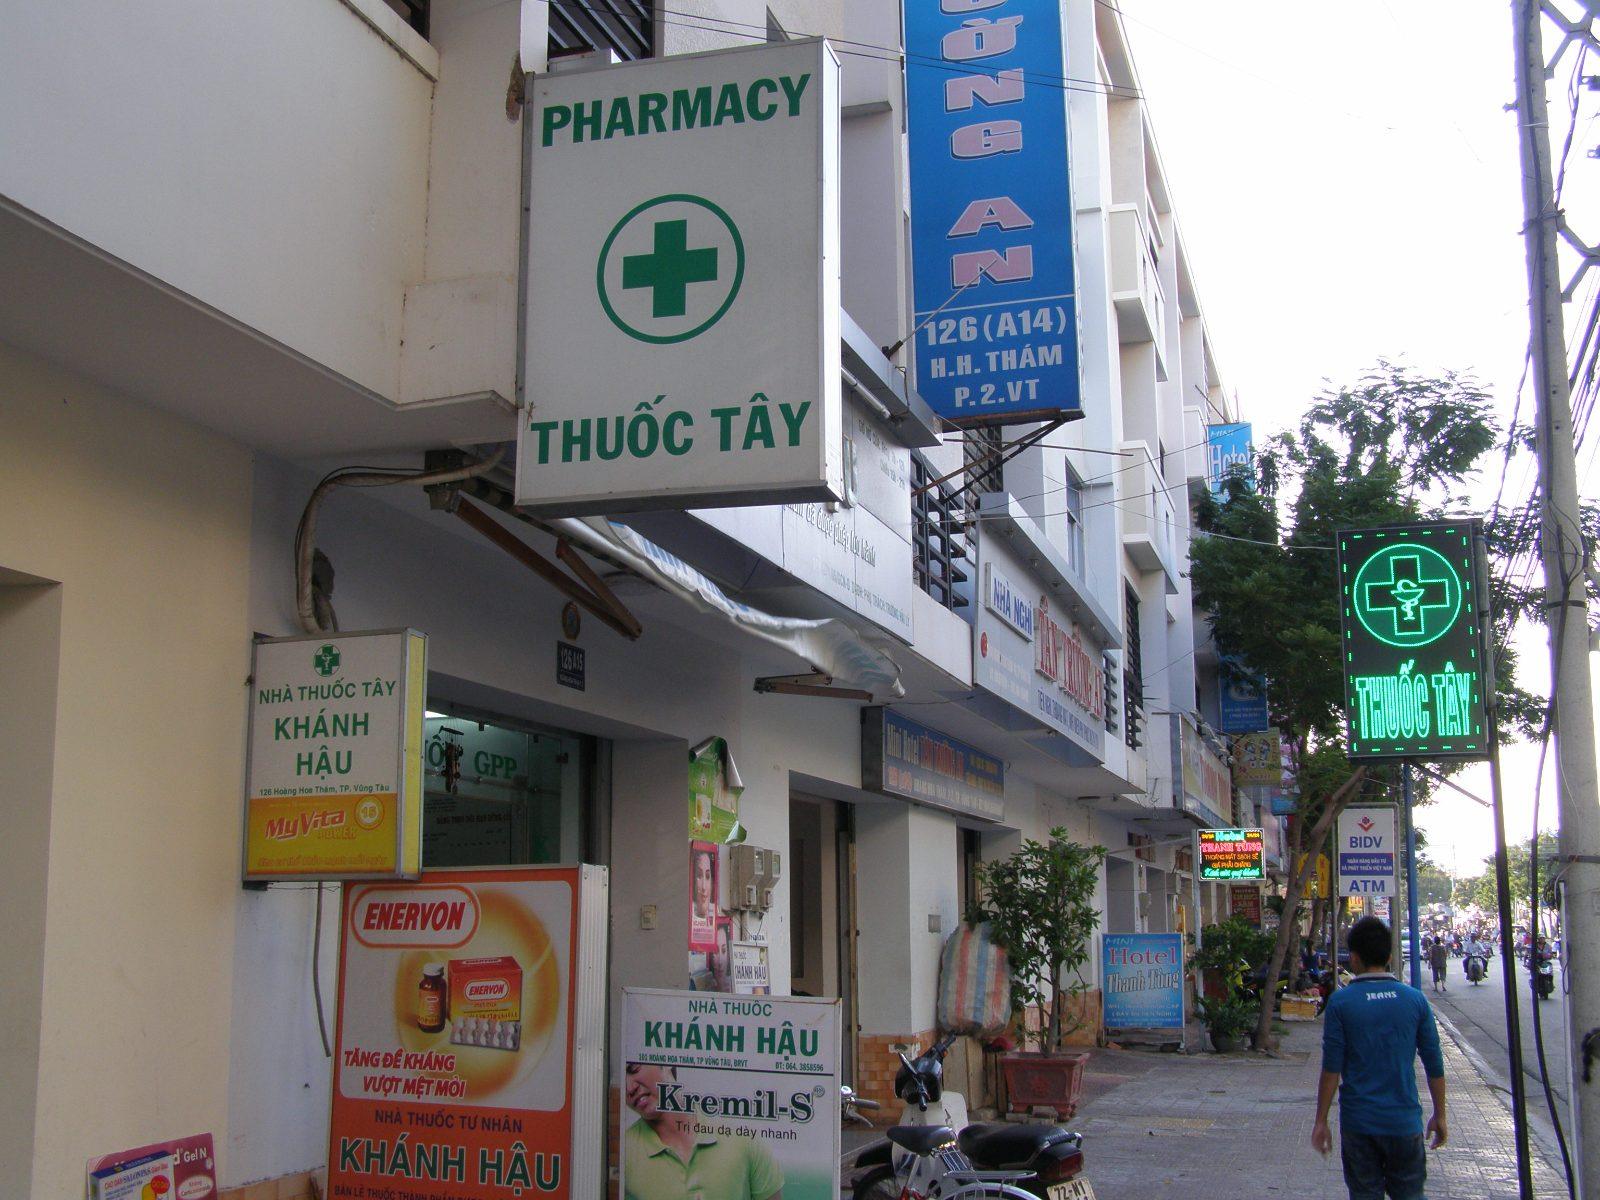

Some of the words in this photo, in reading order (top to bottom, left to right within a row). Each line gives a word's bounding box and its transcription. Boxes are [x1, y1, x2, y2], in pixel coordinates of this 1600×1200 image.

[542, 74, 811, 148] PHARMACY
[946, 196, 1035, 290] AN
[924, 316, 978, 346] 126
[983, 306, 1067, 343] (A14)
[931, 354, 981, 379] H.H.
[986, 343, 1063, 371] THÁM
[531, 395, 694, 465] THUỐC
[711, 392, 811, 452] TÂY
[993, 578, 1011, 620] NHÀ
[1014, 596, 1033, 636] NGHỈ
[260, 683, 293, 704] NHÀ
[298, 676, 356, 701] THUỐC
[362, 676, 396, 697] TÂY
[1356, 659, 1430, 739] THUỐC
[1432, 661, 1471, 737] TÂY
[274, 708, 369, 741] KHÁNH
[296, 745, 352, 780] HẬU
[475, 750, 518, 780] GPP
[1350, 836, 1383, 849] BIDV
[1349, 880, 1385, 892] ATM
[363, 901, 466, 932] ENERVON
[1108, 946, 1176, 966] Hotel
[1107, 969, 1145, 993] Thanh
[689, 997, 718, 1015] NHÀ
[722, 998, 773, 1017] THUỐC
[644, 1016, 745, 1053] KHÁNH
[757, 1020, 819, 1061] HẬU
[345, 1048, 381, 1068] TĂNG
[403, 1050, 456, 1071] KHÁNG
[363, 1074, 402, 1097] VƯỢT
[402, 1075, 434, 1099] MỆT
[657, 1083, 814, 1123] Kremil-S
[375, 1108, 402, 1126] NHÀ
[407, 1109, 454, 1130] THUỐC
[459, 1114, 480, 1130] TƯ
[481, 1115, 523, 1134] NHÂN
[675, 1120, 690, 1135] Trị
[694, 1122, 714, 1134] đau
[717, 1124, 731, 1138] dạ
[735, 1125, 758, 1141] dày
[760, 1127, 798, 1142] nhanh
[183, 1147, 198, 1163] Gel
[200, 1146, 208, 1159] N
[340, 1132, 466, 1183] KHÁNH
[479, 1141, 562, 1197] HẬU
